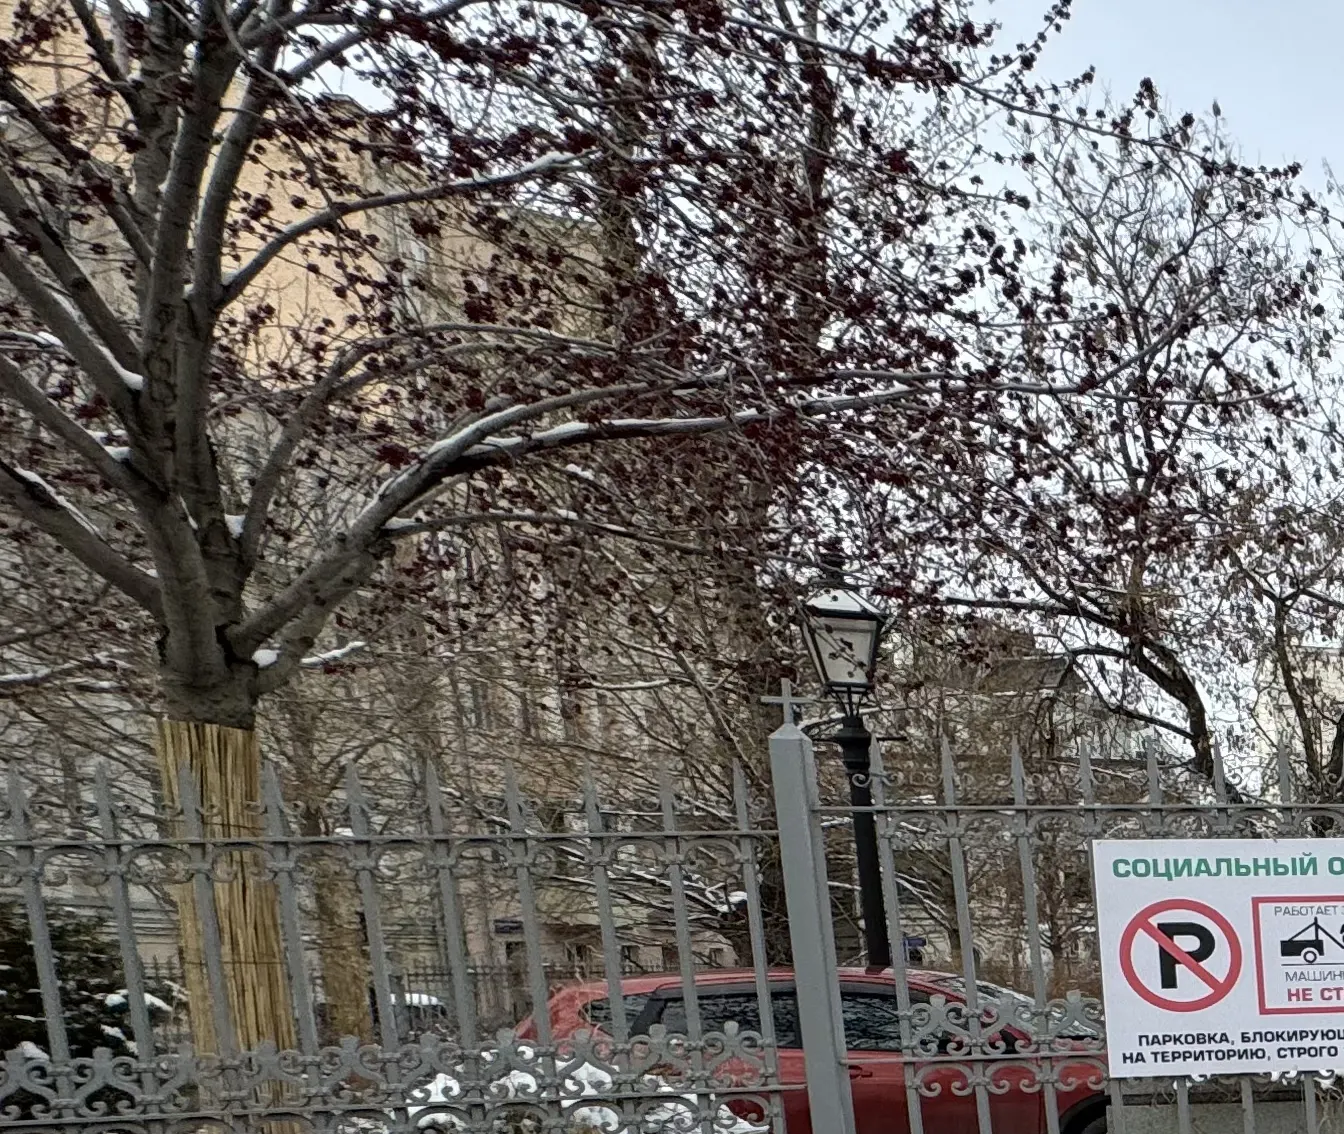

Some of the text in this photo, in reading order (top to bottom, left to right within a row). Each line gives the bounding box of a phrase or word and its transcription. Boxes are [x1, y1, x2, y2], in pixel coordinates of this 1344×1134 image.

[1112, 852, 1318, 881] СОЦИАЛЬНЫЙ
[1274, 905, 1338, 917] РАБОТАЕТ
[1157, 922, 1216, 989] P
[1287, 987, 1313, 1002] НЕ
[1138, 1032, 1236, 1047] ПАРКОВКА,
[1122, 1052, 1147, 1065] НА
[1150, 1048, 1272, 1063] ТЕРРИТОРИЮ,
[1277, 1045, 1339, 1060] СТРОГО
